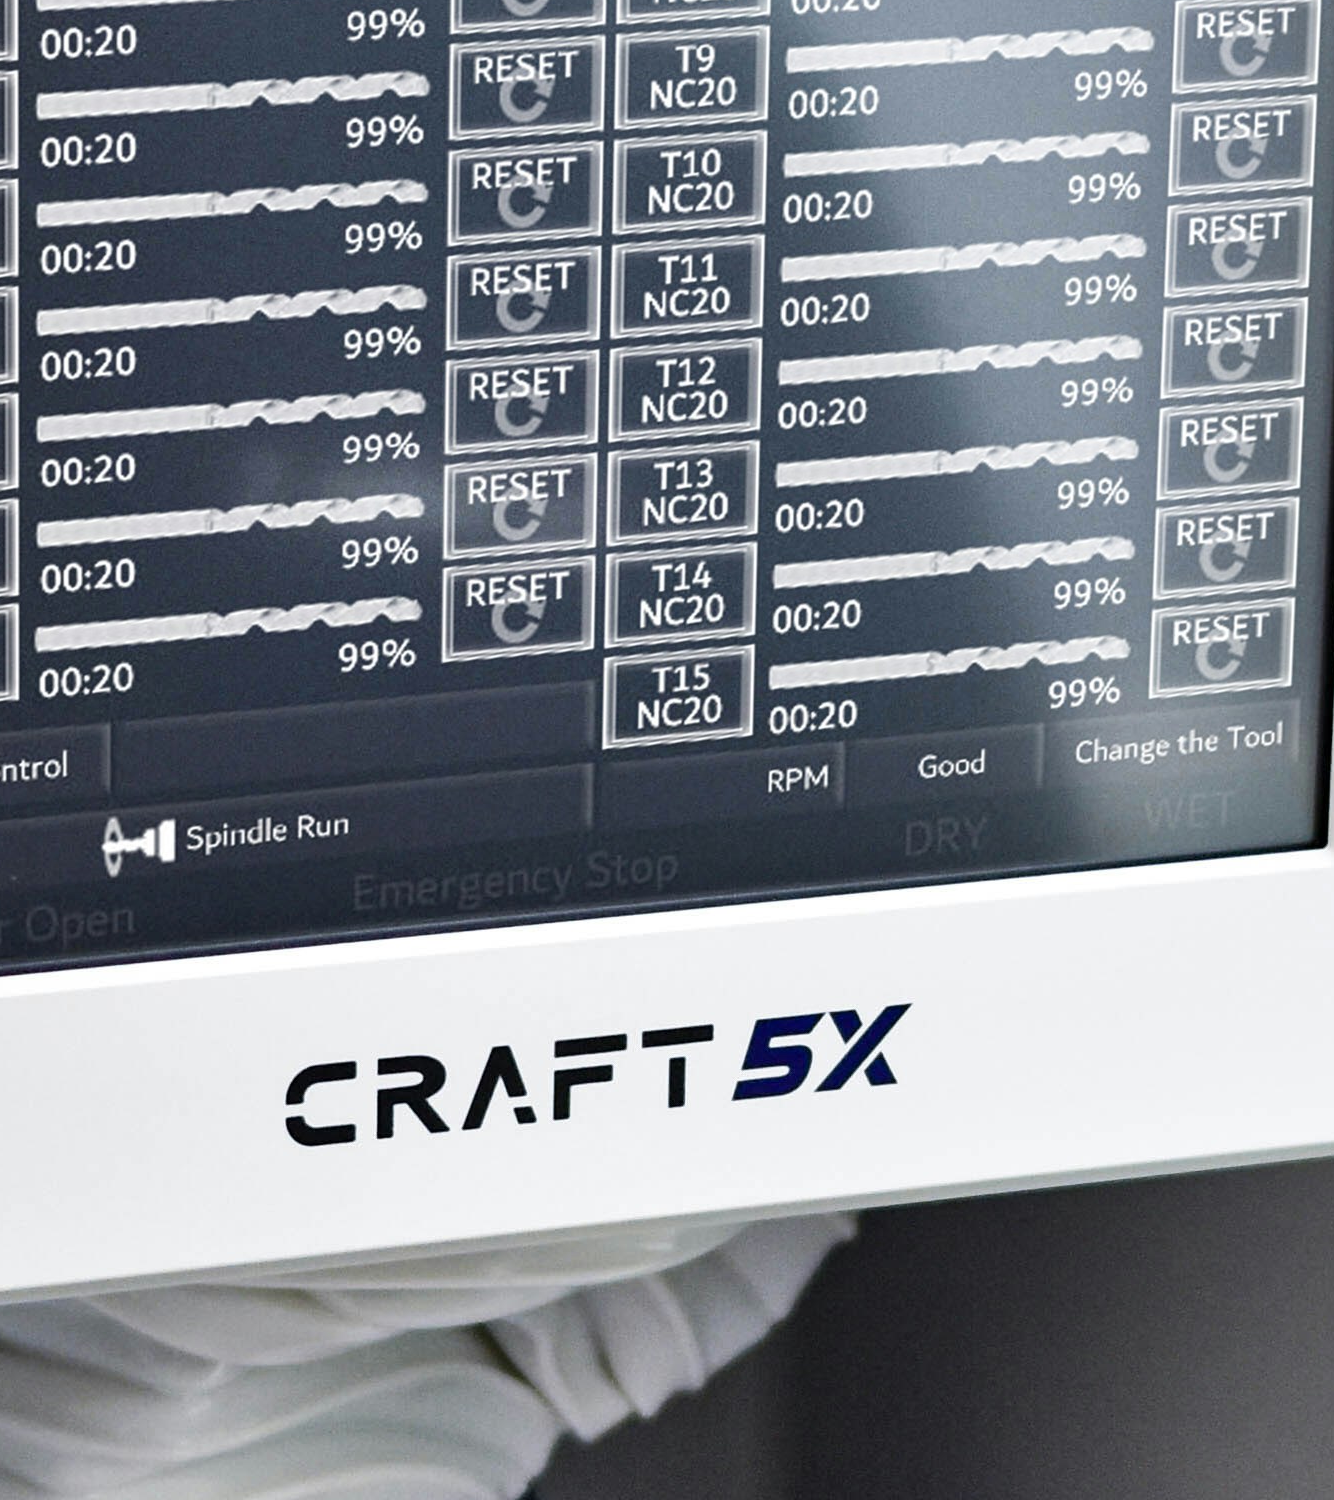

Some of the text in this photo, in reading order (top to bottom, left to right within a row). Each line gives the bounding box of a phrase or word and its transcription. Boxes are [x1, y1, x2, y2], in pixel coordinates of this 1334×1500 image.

[348, 8, 425, 41] 99%
[1196, 6, 1296, 39] RESET
[41, 25, 136, 59] 00:20
[676, 43, 715, 74] T9
[474, 50, 578, 85] RESET
[650, 76, 737, 109] NC20
[789, 85, 879, 119] 00:20
[1075, 70, 1147, 101] 99%
[347, 115, 423, 148] 99%
[1193, 110, 1291, 144] RESET
[41, 132, 136, 167] 00:20
[662, 149, 721, 180] T10
[472, 155, 576, 190] RESET
[1069, 172, 1140, 204] 99%
[647, 182, 734, 215] NC20
[784, 190, 873, 223] 00:20
[346, 221, 422, 254] 99%
[1188, 212, 1288, 246] RESET
[41, 240, 136, 274] 00:20
[659, 254, 718, 284] T11
[471, 261, 575, 296] RESET
[1065, 274, 1137, 306] 99%
[643, 286, 730, 318] NC20
[781, 293, 870, 326] 00:20
[345, 326, 421, 359] 99%
[1184, 313, 1284, 346] RESET
[41, 346, 136, 381] 00:20
[656, 356, 715, 387] T12
[470, 365, 573, 400] RESET
[1062, 377, 1133, 407] 99%
[641, 390, 728, 423] NC20
[778, 397, 867, 429] 00:20
[1180, 413, 1279, 447] RESET
[344, 432, 419, 463] 99%
[41, 453, 135, 487] 00:20
[468, 468, 572, 503] RESET
[655, 458, 713, 489] T13
[643, 492, 728, 524] NC20
[1058, 477, 1129, 509] 99%
[776, 498, 864, 532] 00:20
[1176, 512, 1274, 546] RESET
[343, 536, 418, 568] 99%
[41, 558, 135, 593] 00:20
[466, 571, 570, 607] RESET
[653, 562, 711, 592] T14
[639, 594, 725, 626] NC20
[1055, 578, 1125, 609] 99%
[773, 600, 861, 633] 00:20
[1173, 613, 1270, 647] RESET
[339, 639, 416, 672] 99%
[40, 663, 133, 697] 00:20
[652, 663, 710, 693] T15
[1049, 677, 1120, 708] 99%
[636, 696, 722, 729] NC20
[769, 700, 857, 734] 00:20
[1076, 722, 1282, 764] Change the Tool
[769, 765, 828, 792] RPM
[919, 749, 985, 778] Good
[1143, 791, 1238, 829] WET
[187, 815, 348, 854] Spindle Run
[906, 816, 988, 857] DRY
[353, 851, 679, 914] Emergency Stop
[25, 905, 136, 946] Open
